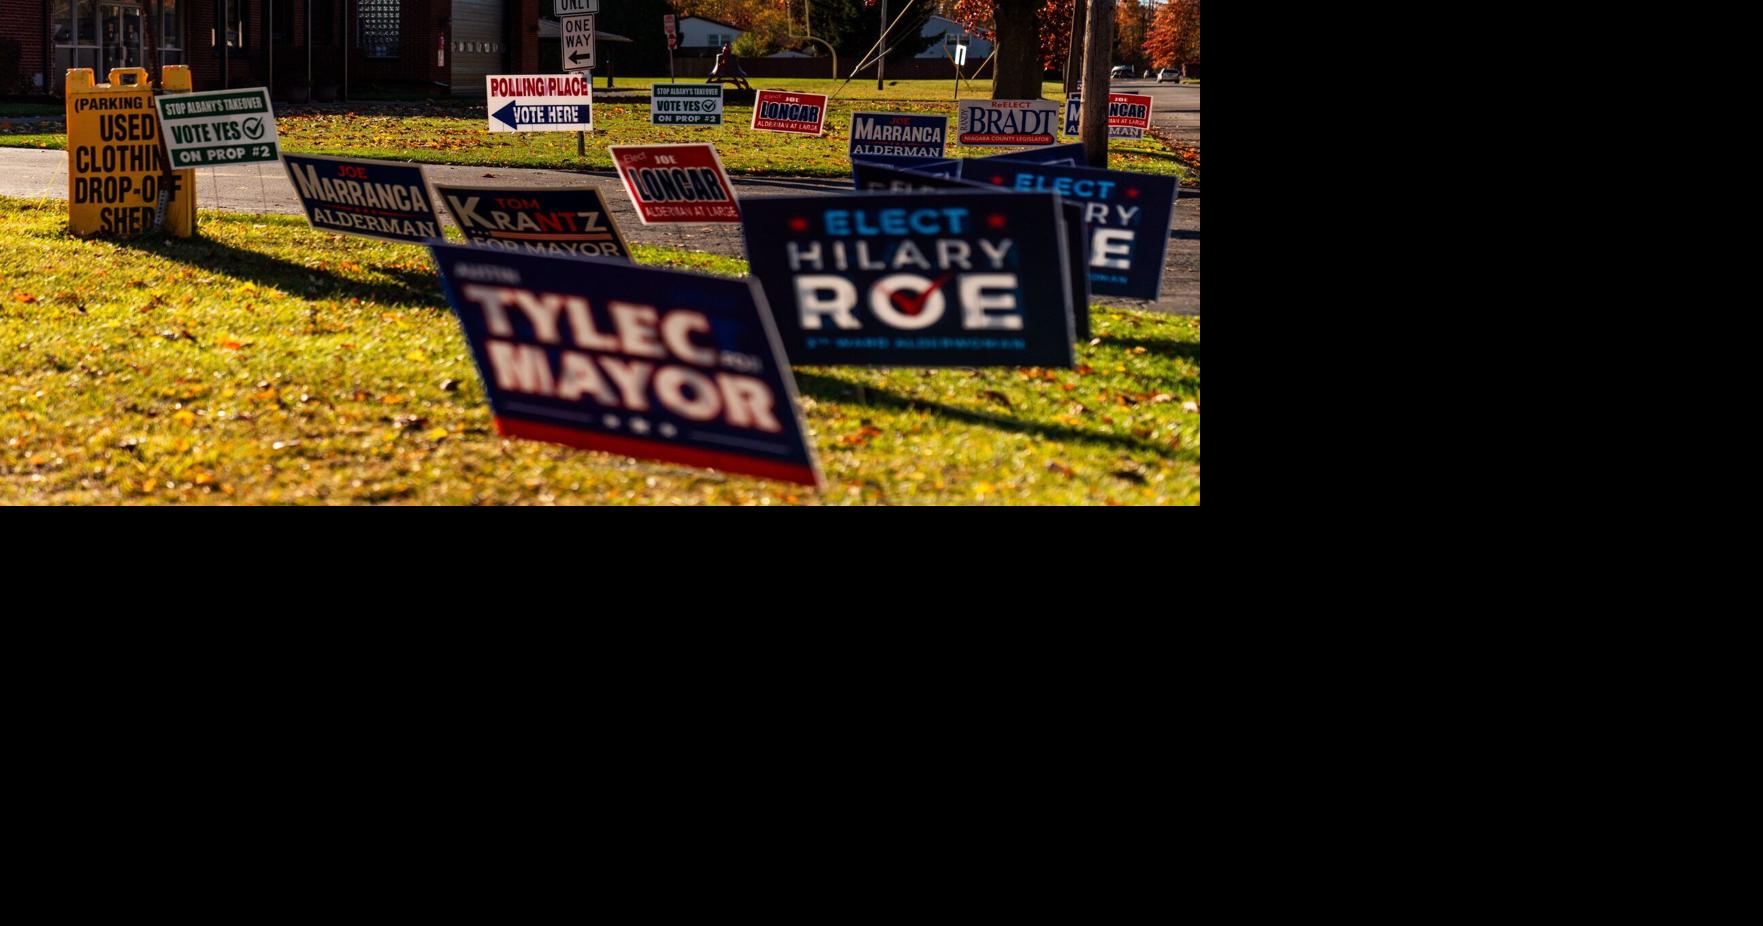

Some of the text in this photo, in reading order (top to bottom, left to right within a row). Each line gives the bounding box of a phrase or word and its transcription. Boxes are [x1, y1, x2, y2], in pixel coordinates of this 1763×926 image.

[565, 19, 591, 32] ONE
[565, 34, 591, 48] WAY
[490, 77, 589, 97] POLLING PLACE
[75, 97, 143, 113] (PARKING
[165, 103, 187, 116] STOP
[187, 99, 224, 114] ALBANY'S
[223, 97, 263, 111] TAKEOVER
[512, 105, 579, 124] VOTE HERE
[656, 100, 701, 112] VOTE YES
[760, 101, 820, 123] LONCAR
[1109, 102, 1147, 119] NCAR
[100, 113, 155, 142] USED
[658, 114, 672, 122] ON
[889, 117, 911, 125] JOE
[967, 106, 1057, 134] BRADT
[170, 120, 242, 145] VOTE YES
[855, 117, 942, 143] MARRANCA
[76, 145, 162, 174] CLOTHIN
[179, 145, 271, 163] ON PROP #2
[653, 155, 678, 164] JOE
[854, 144, 941, 157] ALDERMAN
[338, 164, 368, 180] JOE
[290, 162, 429, 213] MARRANCA
[626, 166, 730, 203] LONCAR
[1014, 173, 1116, 199] ELECT
[447, 195, 608, 233] KRANTZ
[495, 197, 541, 211] TOM
[694, 206, 706, 217] AT
[101, 206, 156, 235] SHED
[313, 207, 437, 239] ALDERMAN
[823, 208, 969, 236] ELECT
[522, 241, 621, 257] MAYOR
[785, 238, 1014, 272] HILARY
[794, 272, 1025, 332] ROE
[462, 283, 718, 366] TYLEC
[485, 339, 784, 434] MAYOR
